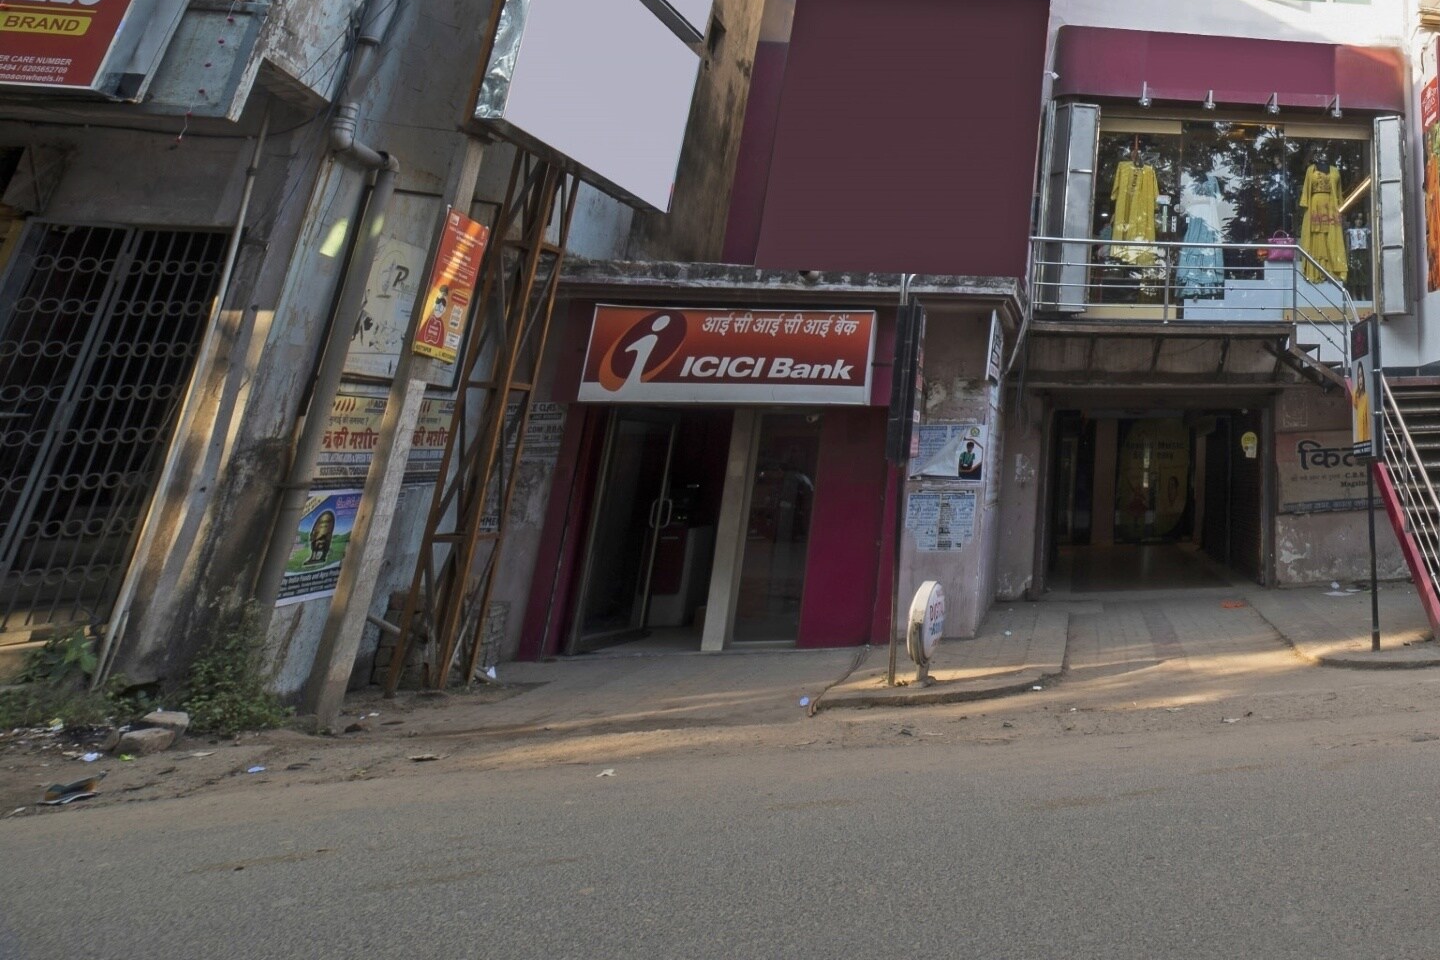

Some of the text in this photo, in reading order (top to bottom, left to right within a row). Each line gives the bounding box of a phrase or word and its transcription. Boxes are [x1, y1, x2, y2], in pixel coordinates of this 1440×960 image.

[3, 14, 80, 32] BRAND
[11, 55, 35, 64] CARE
[36, 57, 72, 66] NUMBER
[702, 312, 860, 338] आई सी आई सी आई बैंक
[680, 356, 854, 380] ICICI Bank
